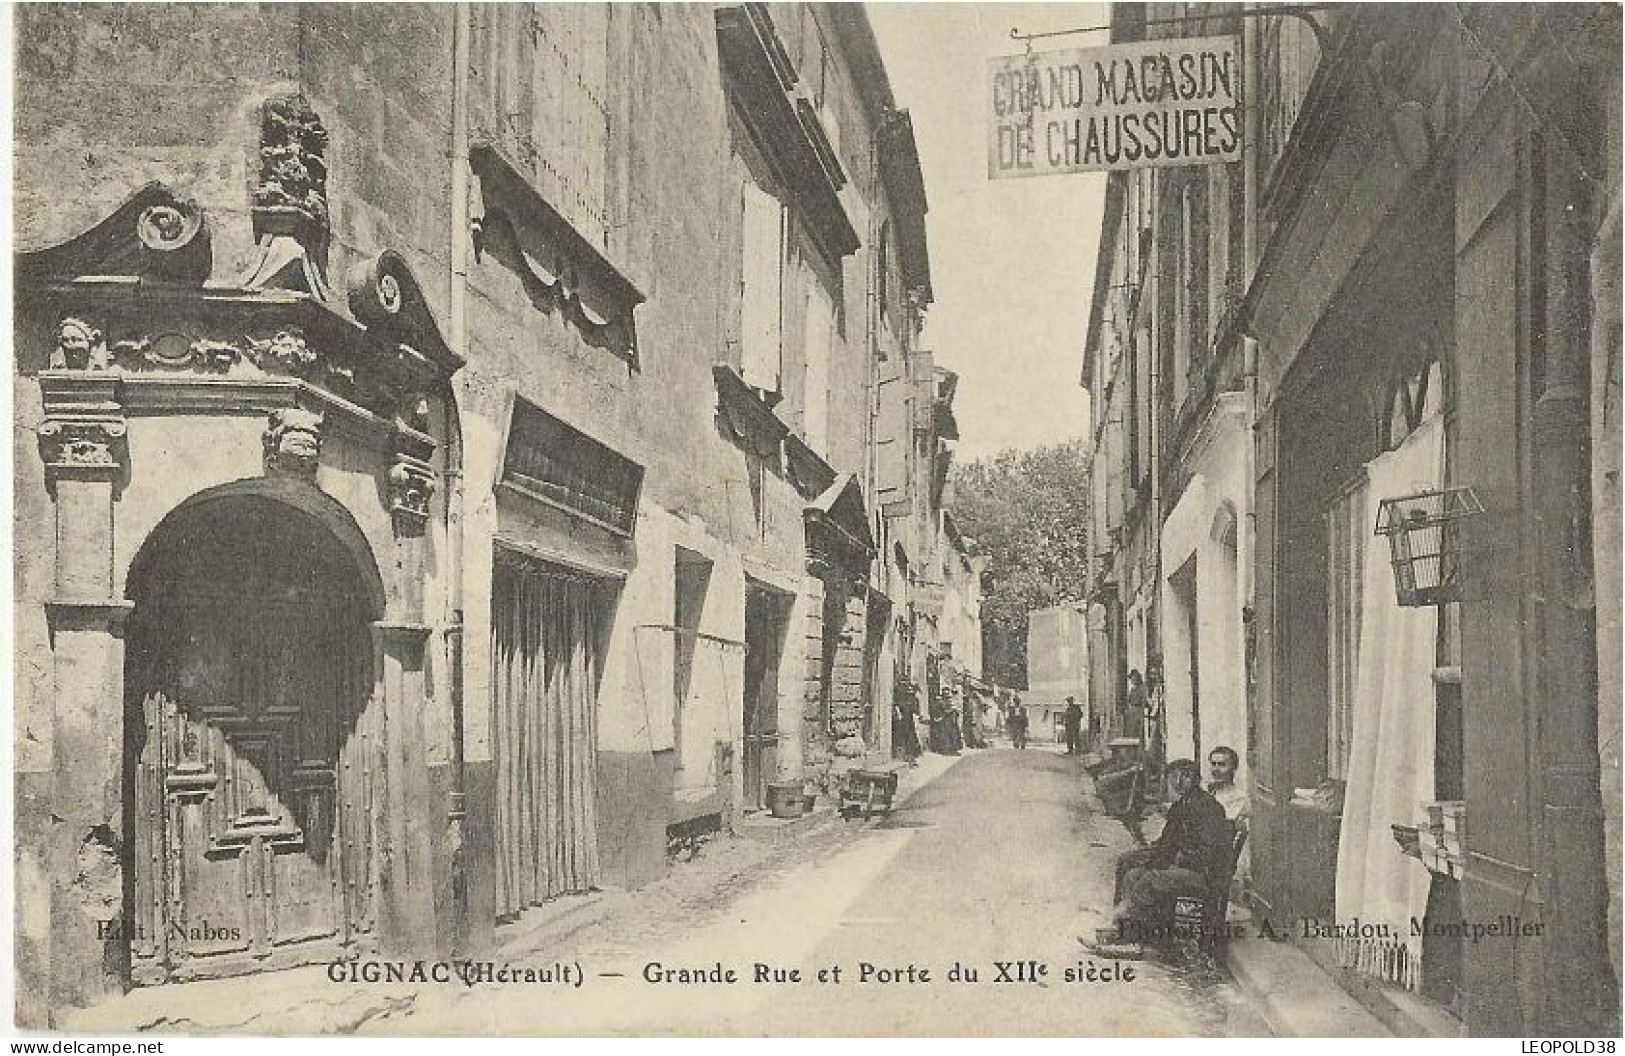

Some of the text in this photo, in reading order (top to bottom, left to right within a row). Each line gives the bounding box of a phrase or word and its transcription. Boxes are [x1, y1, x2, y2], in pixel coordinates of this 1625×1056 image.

[993, 52, 1232, 116] GRAND MAGASIN
[998, 106, 1238, 170] DE CHAUSSURES
